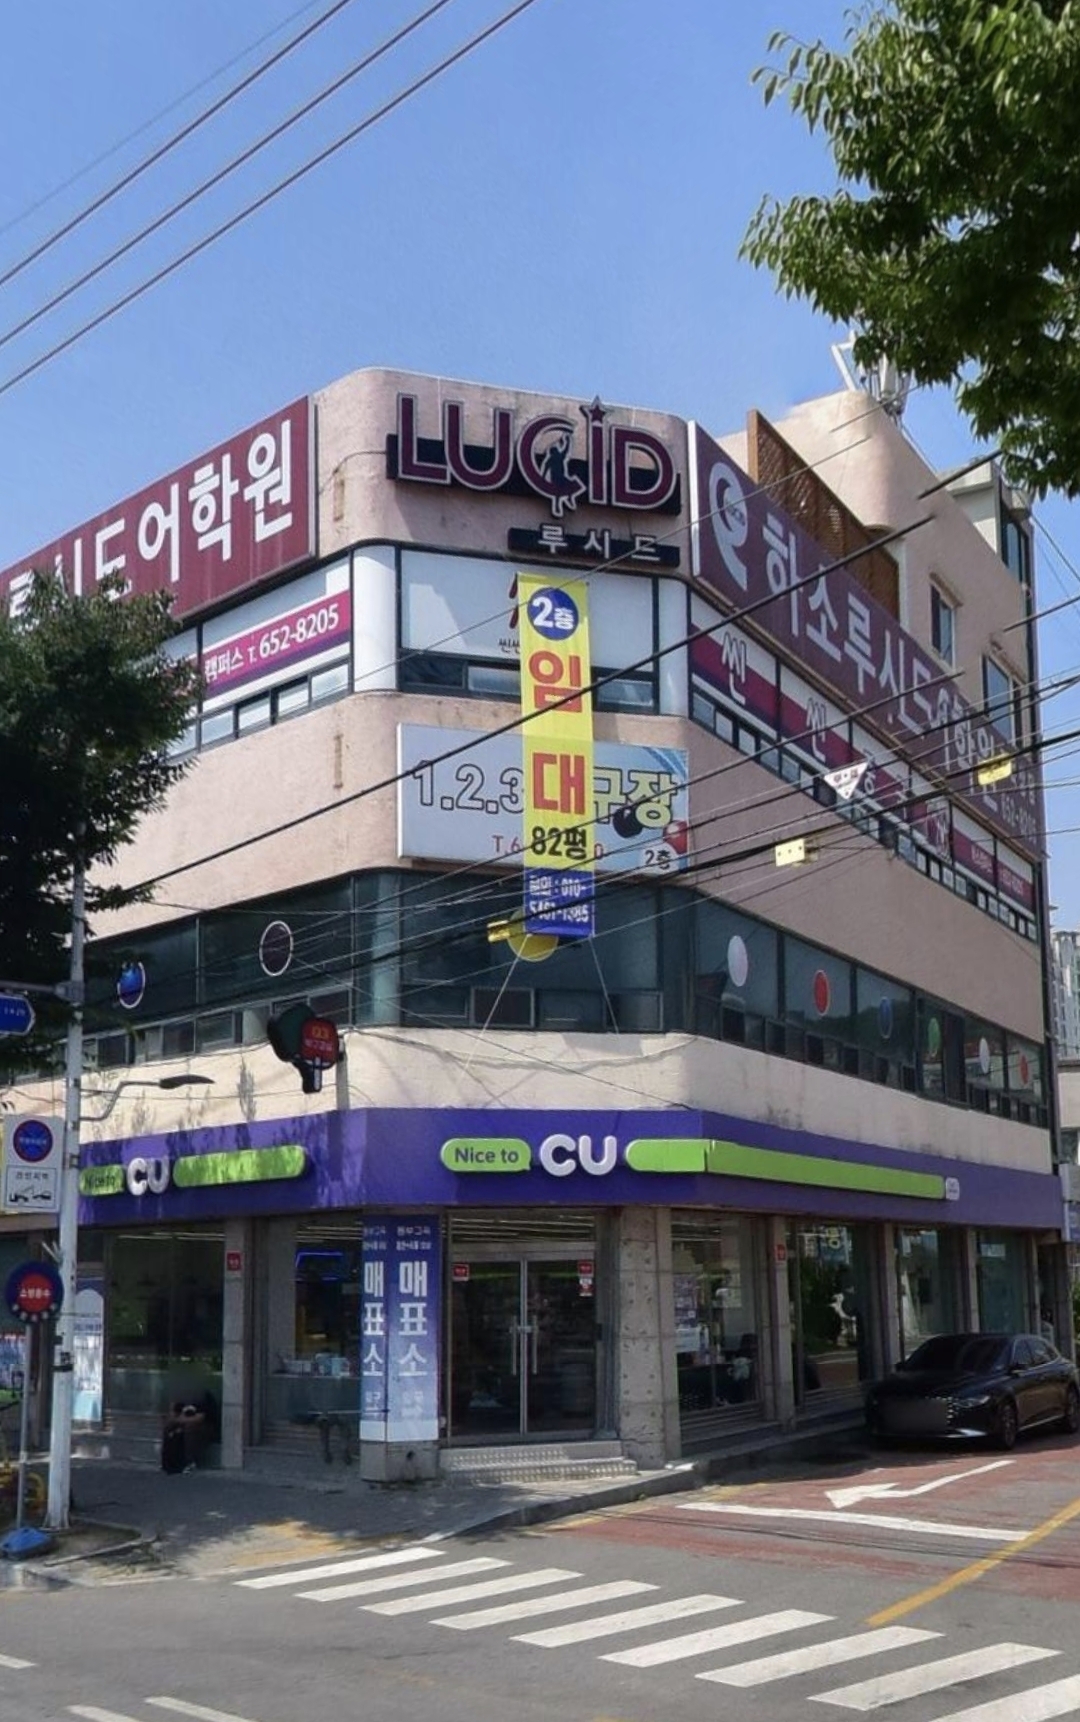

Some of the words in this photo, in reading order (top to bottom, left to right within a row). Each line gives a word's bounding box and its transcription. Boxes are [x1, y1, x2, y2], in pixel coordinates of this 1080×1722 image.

[397, 394, 677, 513] LUCID
[532, 596, 574, 630] 2층
[204, 647, 244, 684] 캠퍼스
[259, 603, 339, 658] 652-8205
[530, 825, 587, 861] 82평
[645, 850, 671, 870] 2층
[127, 1155, 169, 1196] CU
[455, 1147, 496, 1164] Nice
[500, 1149, 519, 1164] to
[539, 1133, 618, 1177] CU
[363, 1260, 385, 1377] 매표소
[398, 1260, 429, 1377] 매표소
